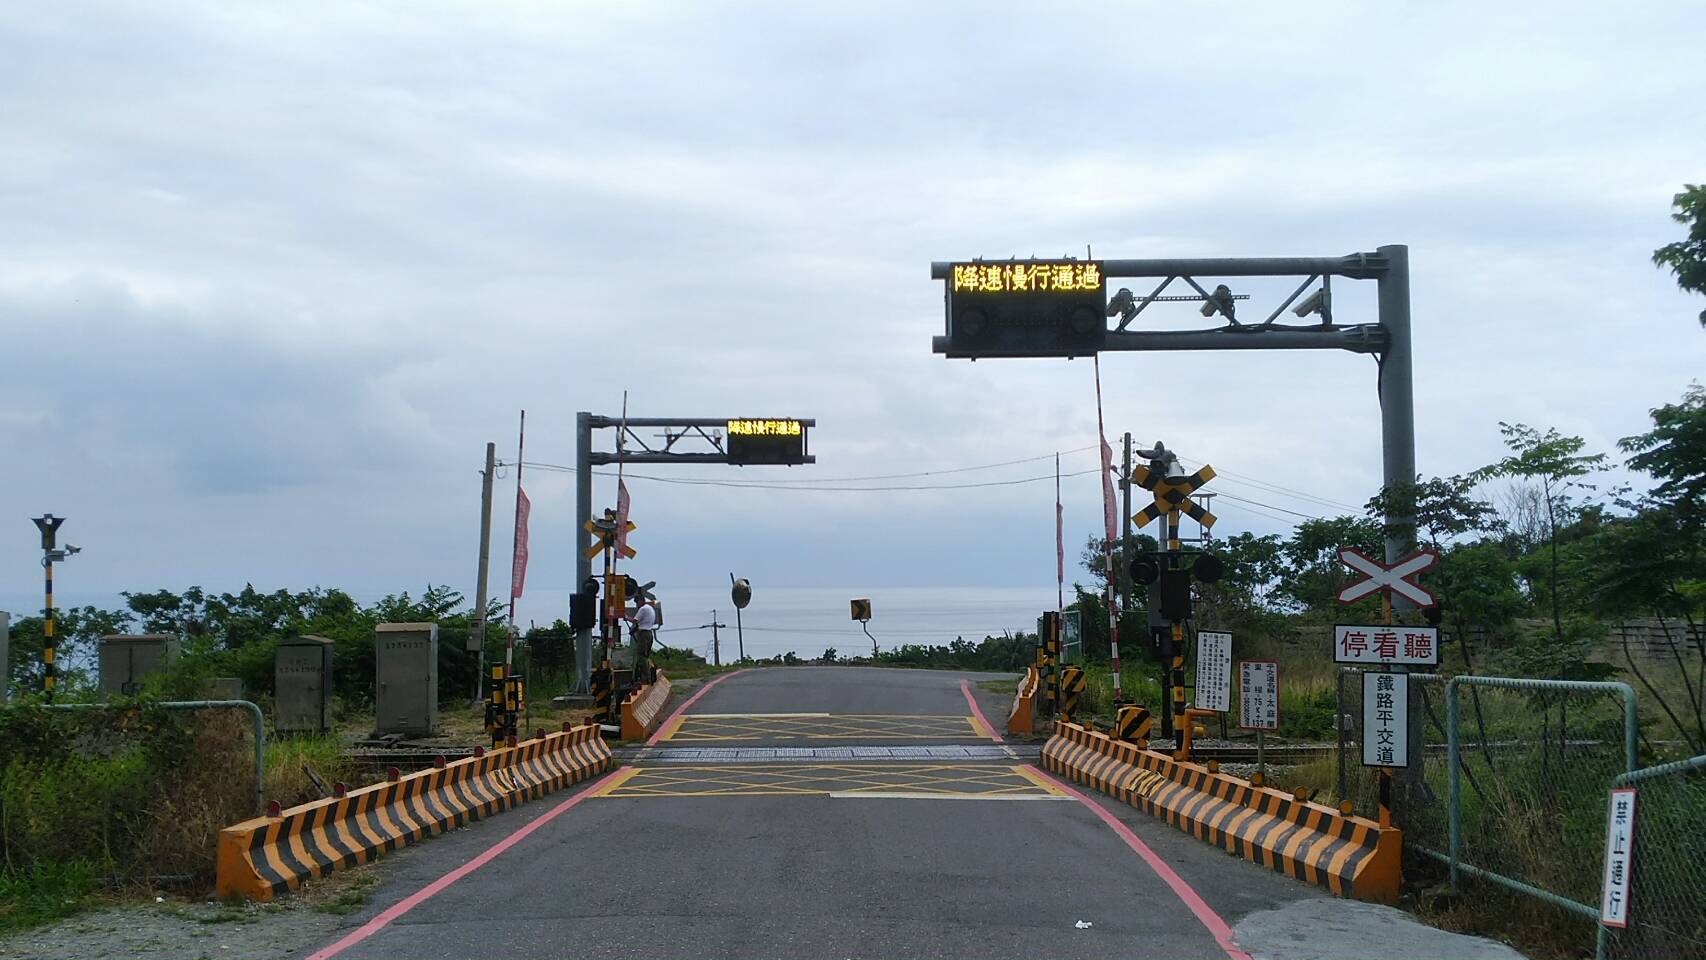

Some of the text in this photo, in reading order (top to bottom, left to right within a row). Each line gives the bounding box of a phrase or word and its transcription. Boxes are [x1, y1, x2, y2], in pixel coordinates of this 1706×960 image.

[954, 263, 1100, 292] 降速慢行通過
[1341, 631, 1433, 659] 停看聽
[1376, 675, 1395, 764] 鐵路平交道
